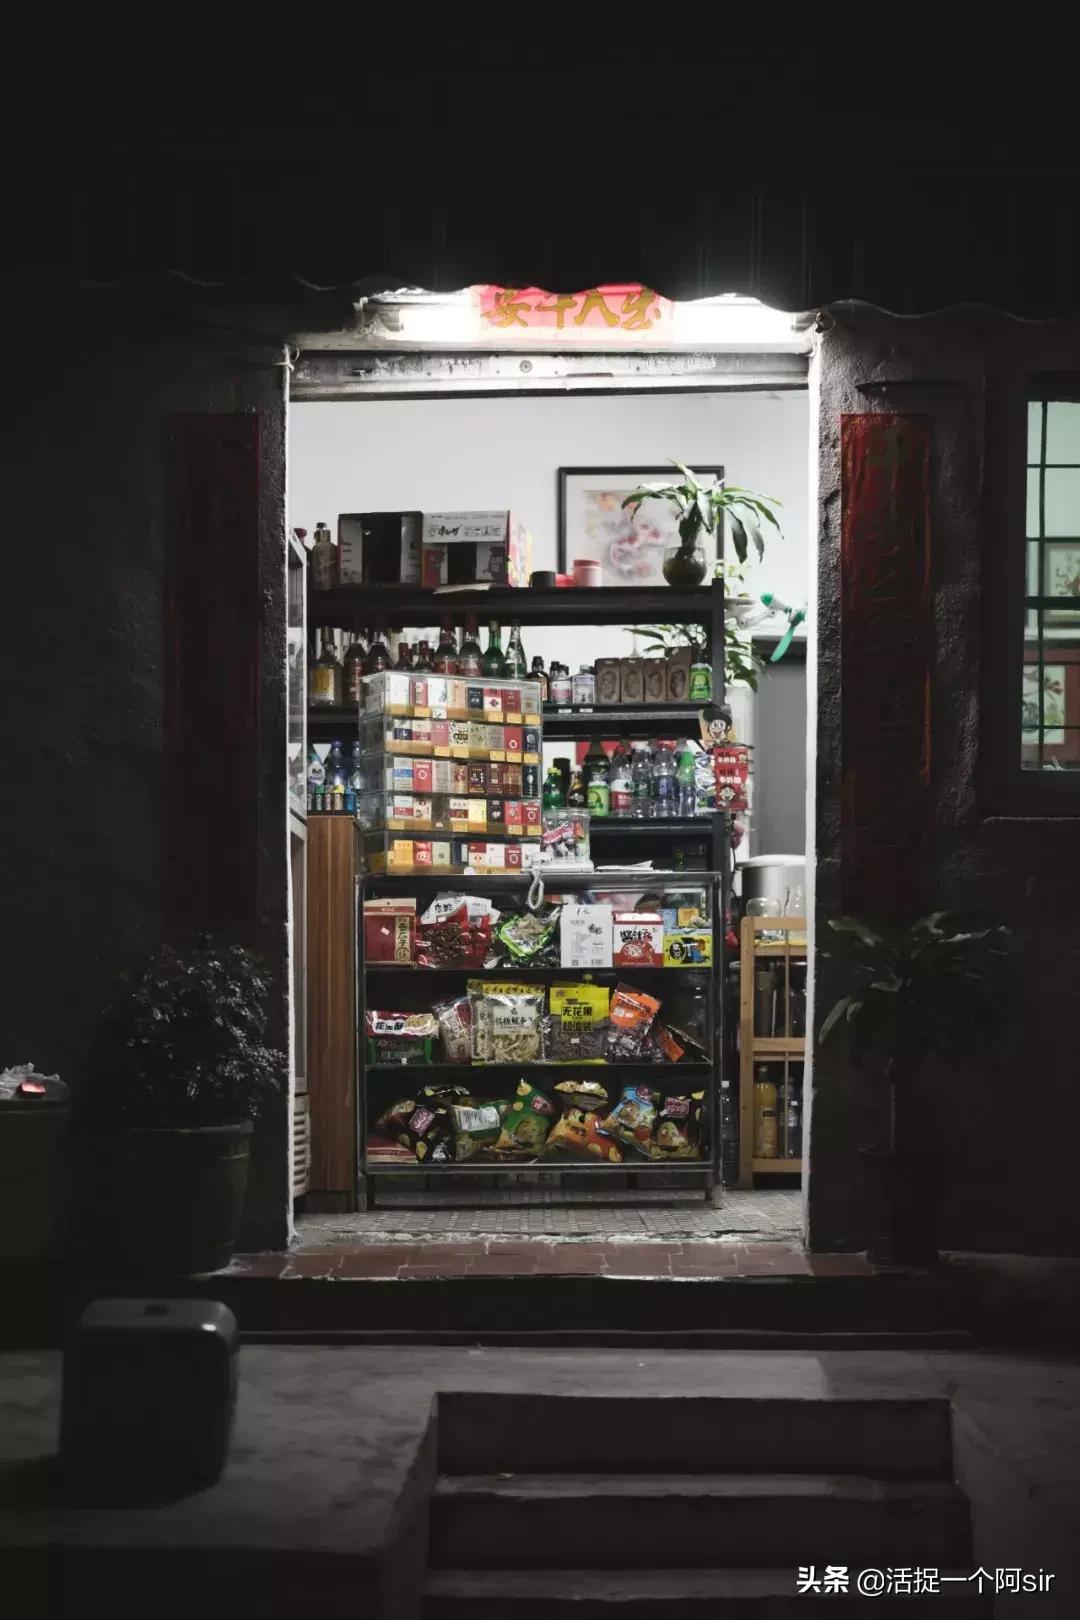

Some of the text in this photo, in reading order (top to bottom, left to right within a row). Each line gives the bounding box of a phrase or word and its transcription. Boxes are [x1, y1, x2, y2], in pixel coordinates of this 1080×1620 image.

[562, 1006, 593, 1017] 无花果
[375, 1021, 404, 1031] 花生酥
[562, 1021, 593, 1032] 超值装
